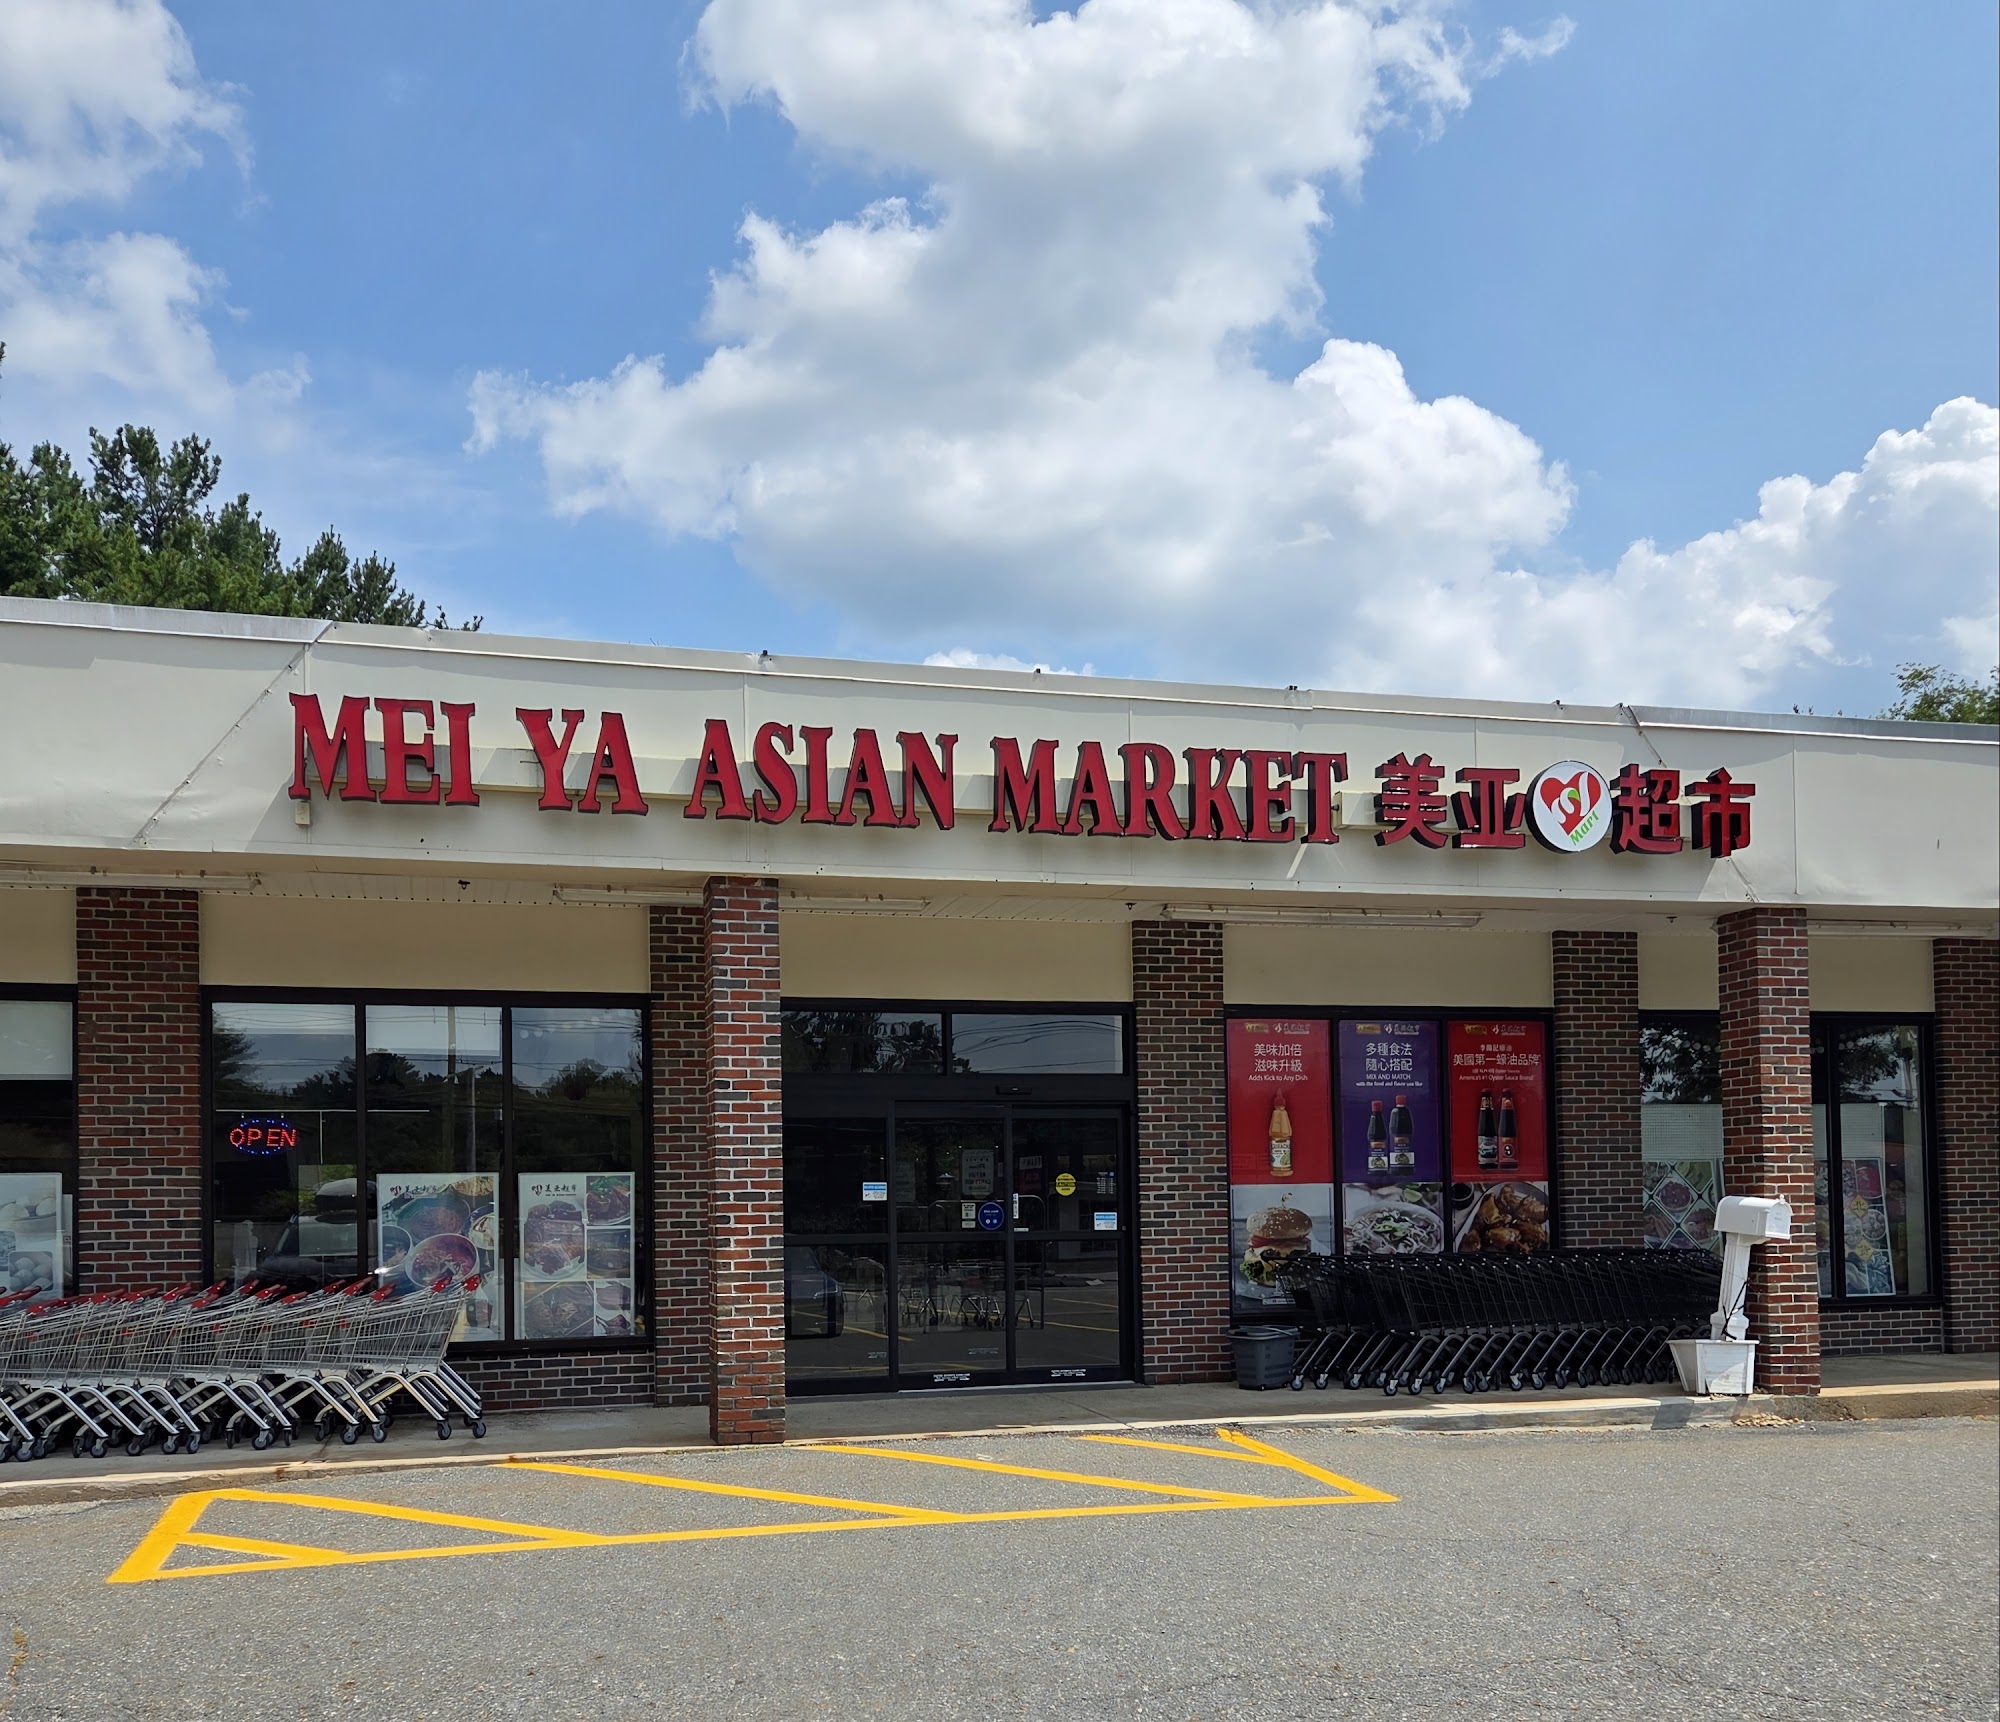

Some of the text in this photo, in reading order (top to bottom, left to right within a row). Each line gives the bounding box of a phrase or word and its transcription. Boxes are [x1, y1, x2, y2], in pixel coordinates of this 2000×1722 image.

[289, 692, 1347, 844] MEI YA ASIAN MARKET
[1373, 753, 1756, 857] 美亚 超市
[1254, 1043, 1303, 1057] 美味加倍
[1365, 1042, 1413, 1056] 多種食法
[1254, 1059, 1303, 1073] 滋味升級
[1365, 1058, 1413, 1072] 隨心搭配
[229, 1127, 297, 1148] OPEN
